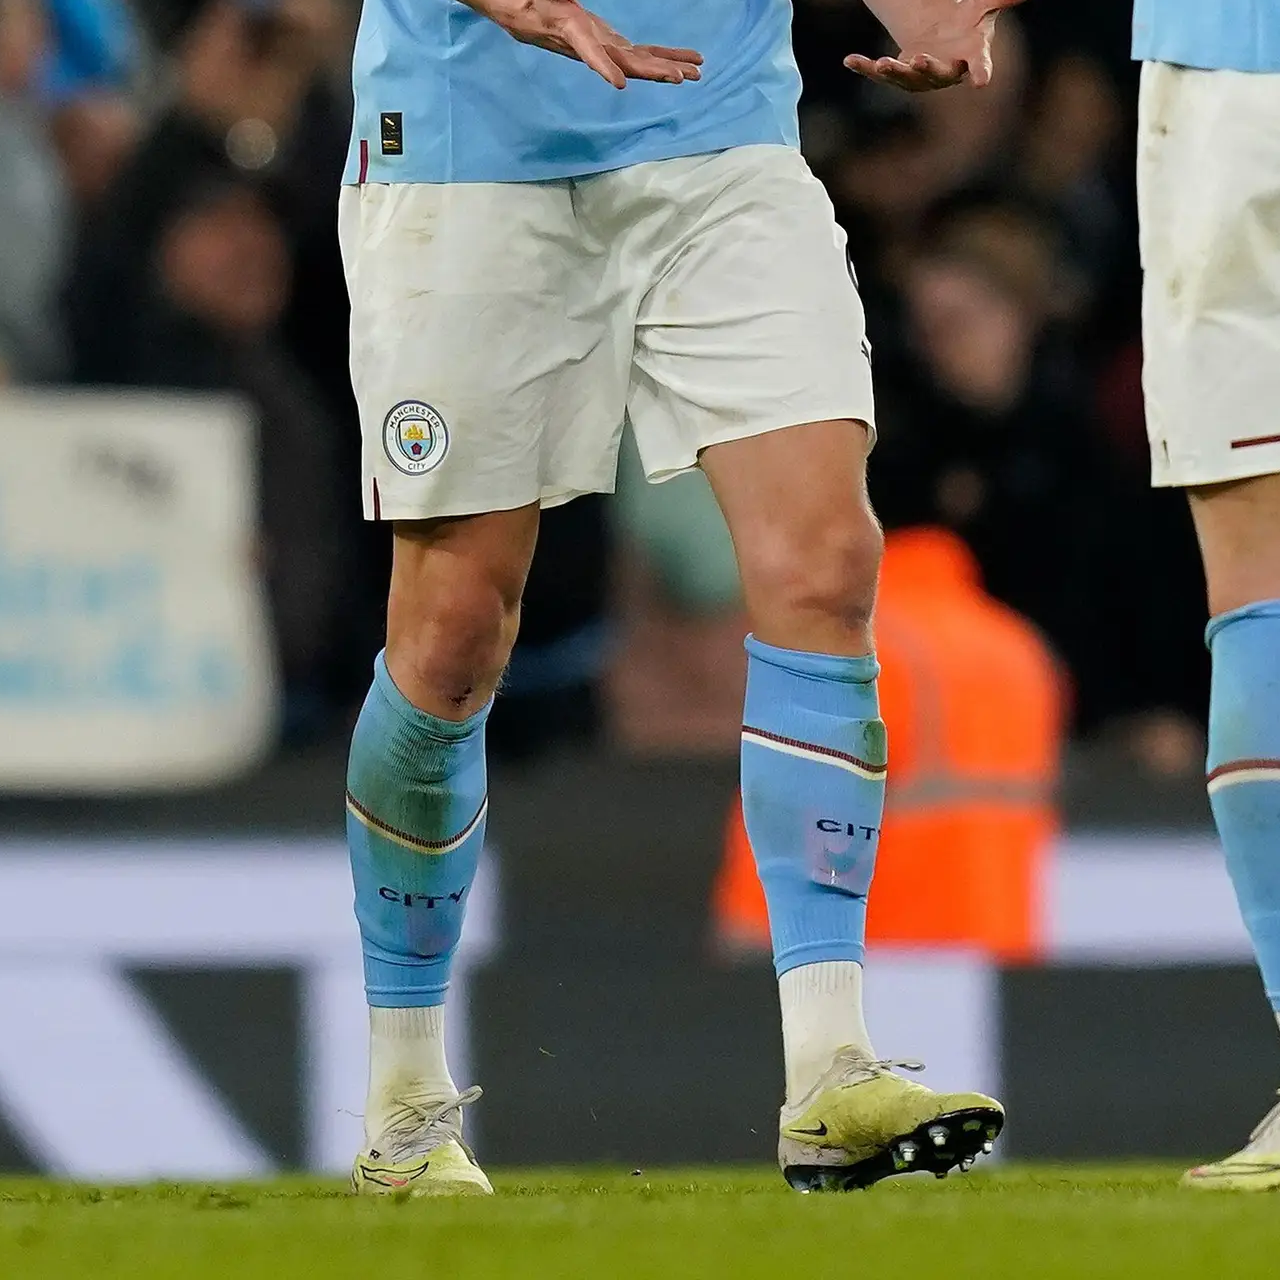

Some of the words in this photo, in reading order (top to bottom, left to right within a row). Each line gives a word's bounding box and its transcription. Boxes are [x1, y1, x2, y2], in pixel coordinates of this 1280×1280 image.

[389, 405, 441, 429] MANCHESTER
[407, 462, 427, 471] CITY
[816, 819, 881, 840] CIT
[378, 886, 467, 909] CITY
